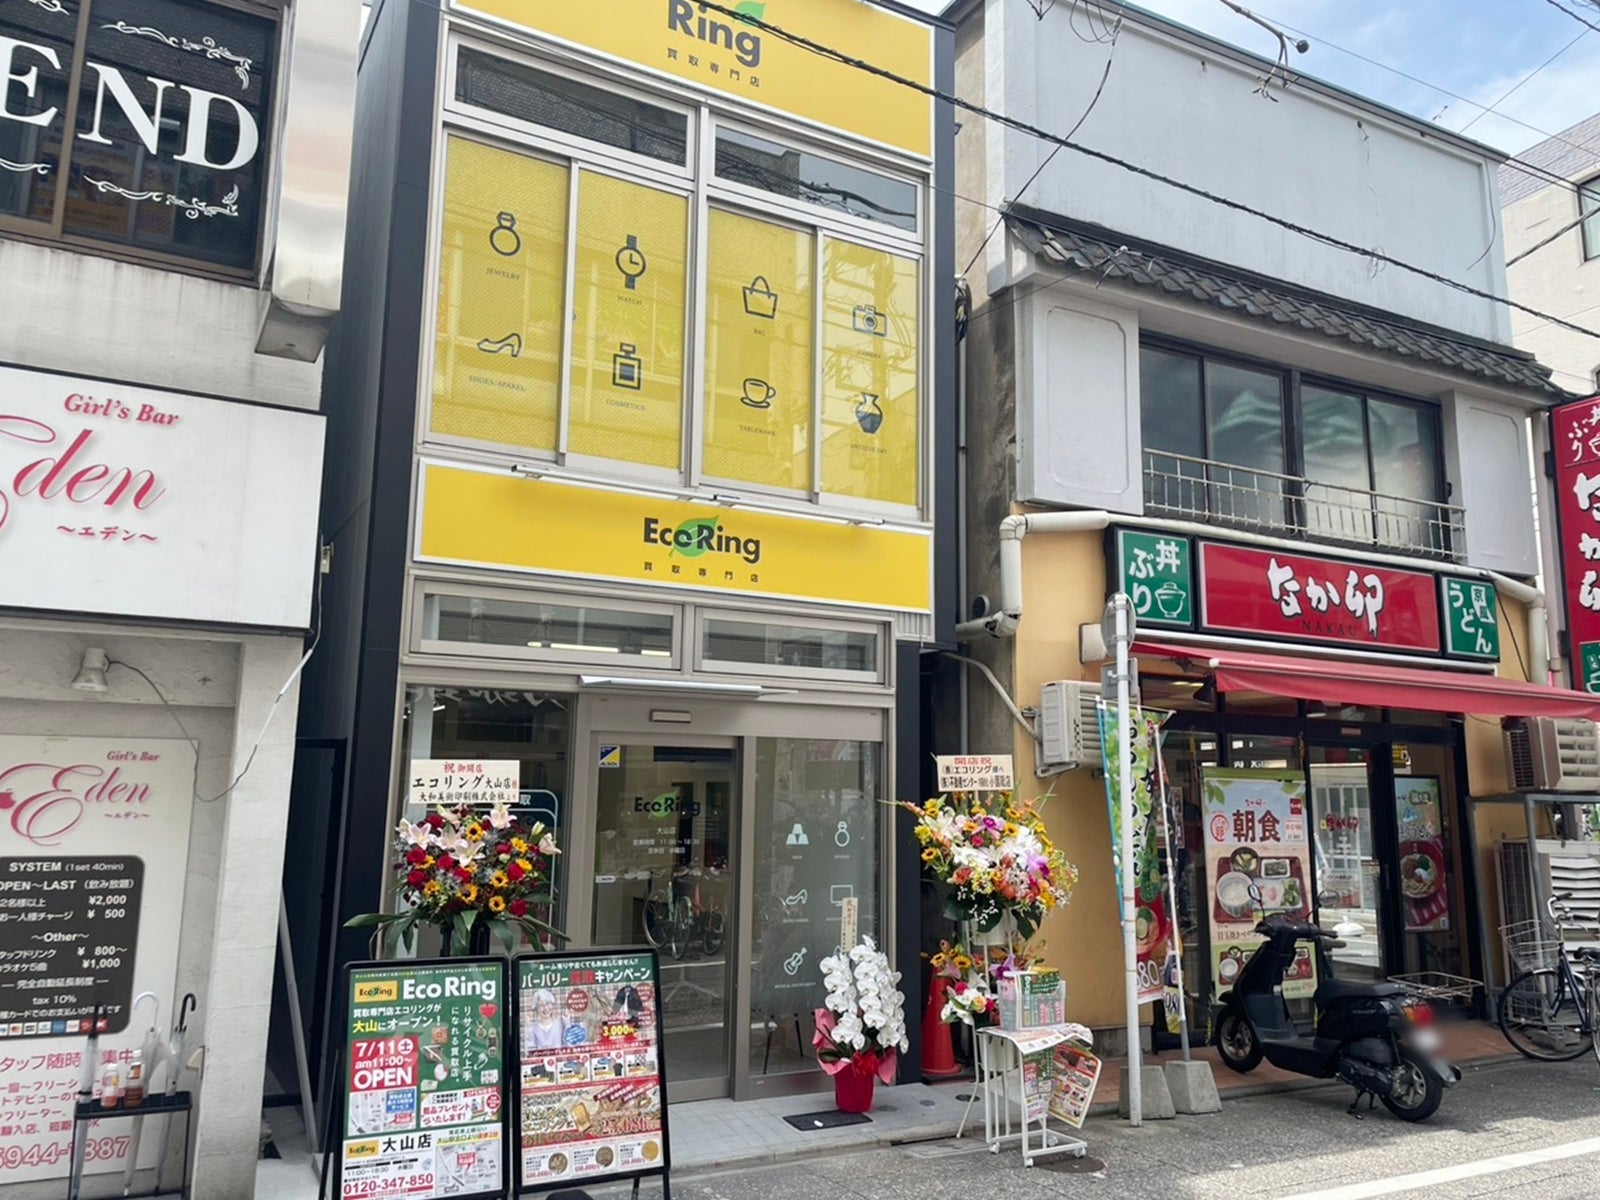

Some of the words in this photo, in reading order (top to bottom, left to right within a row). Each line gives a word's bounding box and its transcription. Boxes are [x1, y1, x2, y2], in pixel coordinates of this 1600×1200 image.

[667, 0, 761, 68] Ring
[136, 404, 180, 427] Bar
[643, 516, 761, 564] EcoRing
[1267, 557, 1384, 640] なか卯
[1232, 809, 1281, 842] 朝食
[9, 861, 62, 872] SYSTEM
[104, 909, 126, 919] 500
[53, 994, 77, 1004] 10%
[356, 1041, 396, 1057] 7/11
[354, 1066, 413, 1090] OPEN
[0, 1135, 130, 1169] 944-887
[383, 1133, 432, 1153] 大山店
[343, 1172, 434, 1195] 0120-347-850
